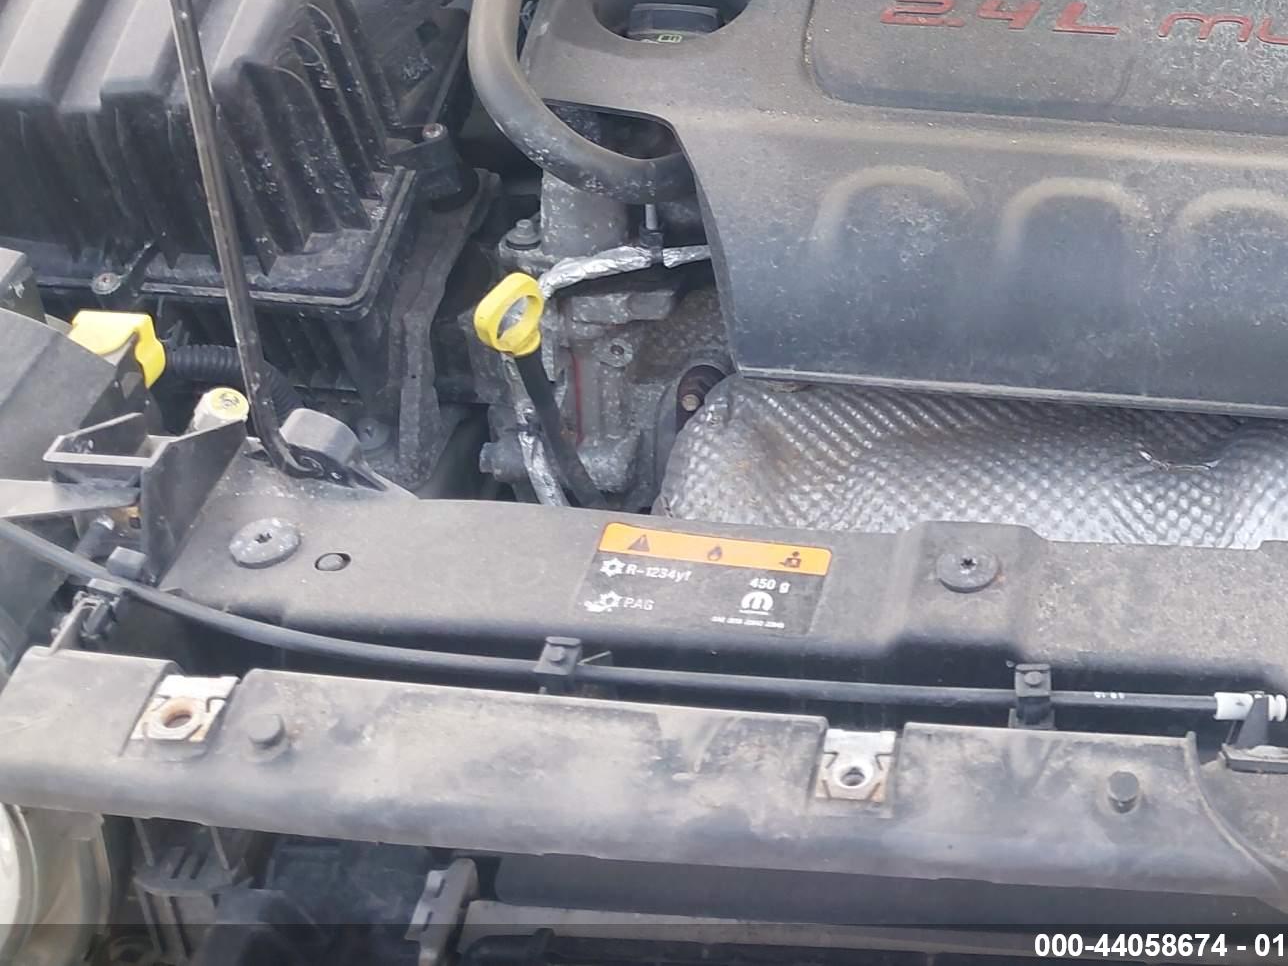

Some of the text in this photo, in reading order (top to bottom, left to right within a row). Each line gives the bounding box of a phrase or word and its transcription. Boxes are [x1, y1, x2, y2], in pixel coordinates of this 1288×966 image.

[626, 564, 692, 583] R-1234yf
[749, 577, 790, 594] 450 g
[623, 596, 655, 612] PAG
